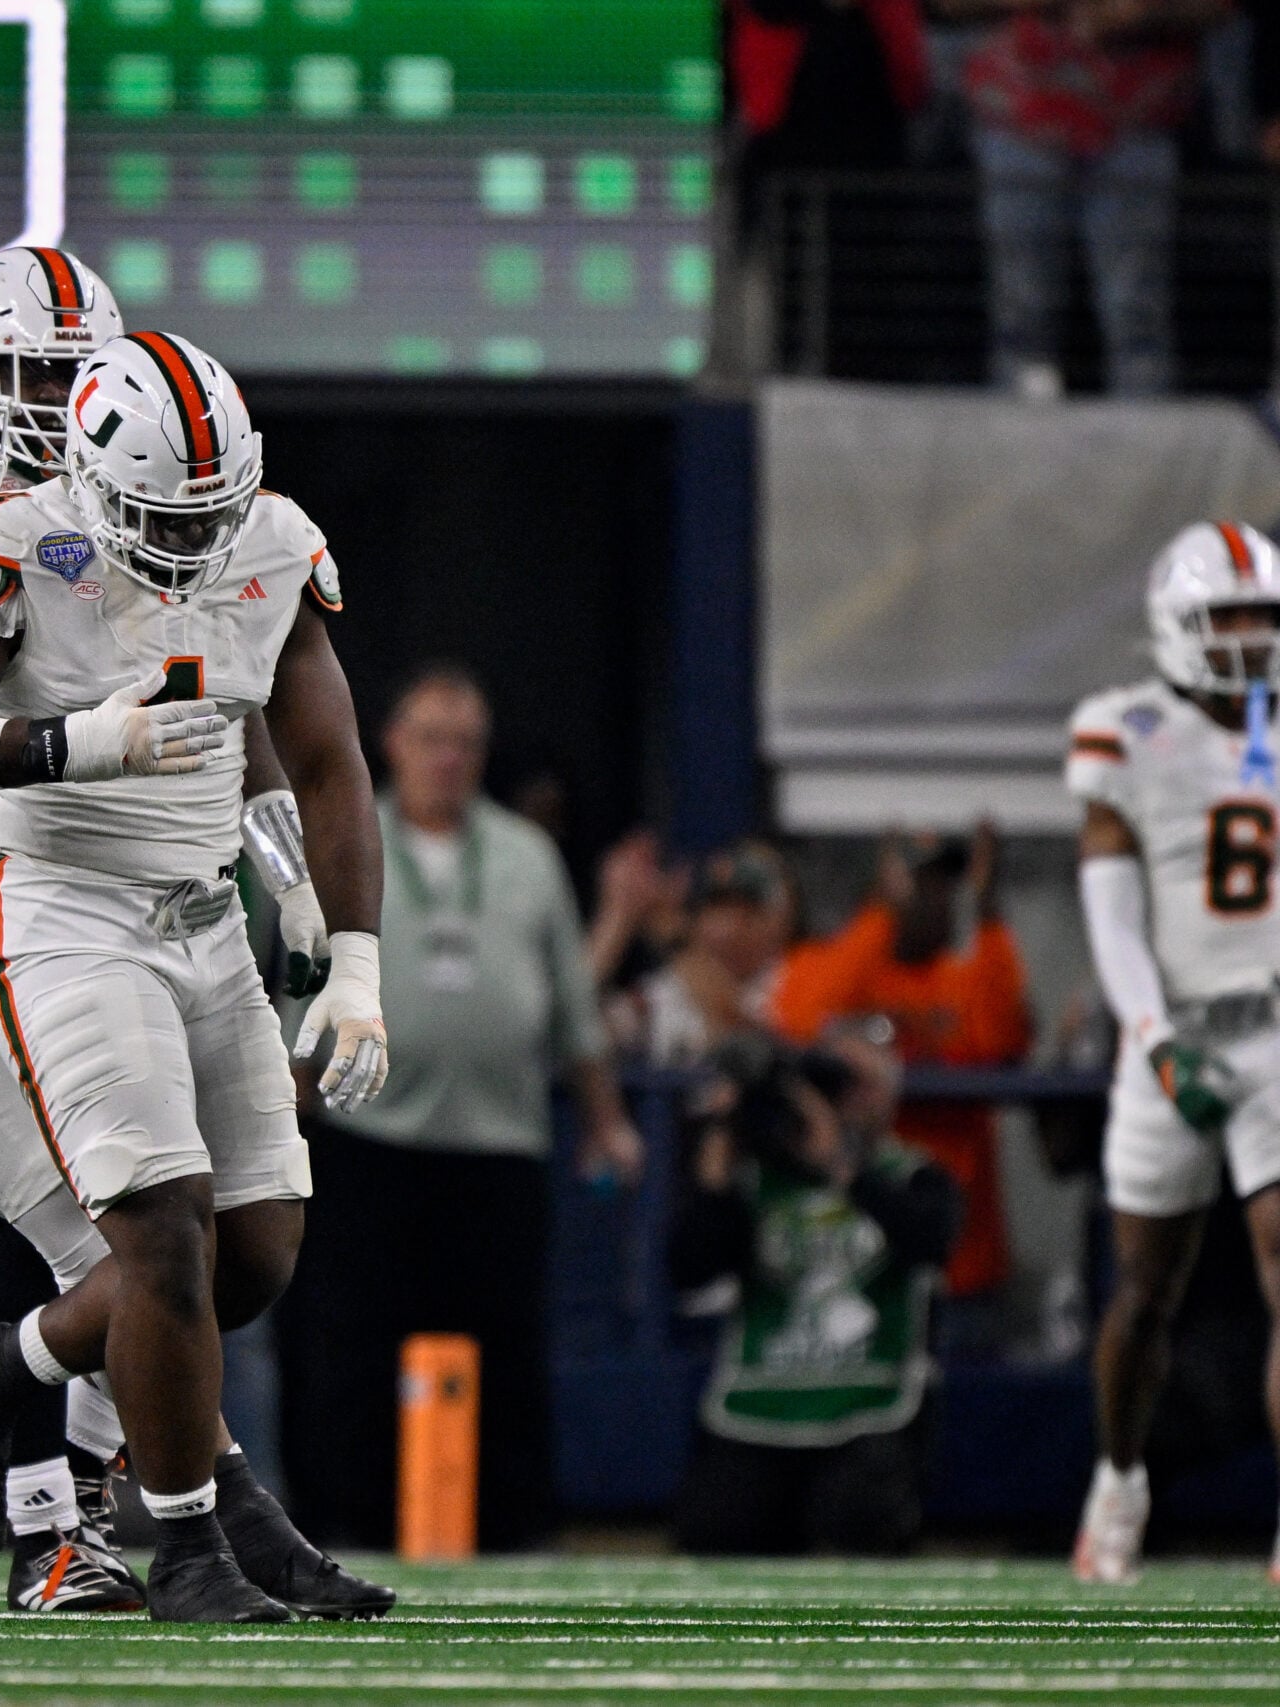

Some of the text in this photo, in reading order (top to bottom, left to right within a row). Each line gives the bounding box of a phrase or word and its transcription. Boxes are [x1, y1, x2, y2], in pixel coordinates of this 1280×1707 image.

[55, 331, 93, 341] MIAMI
[189, 478, 226, 496] MIAMI
[41, 541, 91, 562] COTTON
[52, 552, 83, 565] BOWL
[75, 585, 101, 593] ACC
[1206, 797, 1273, 918] 6
